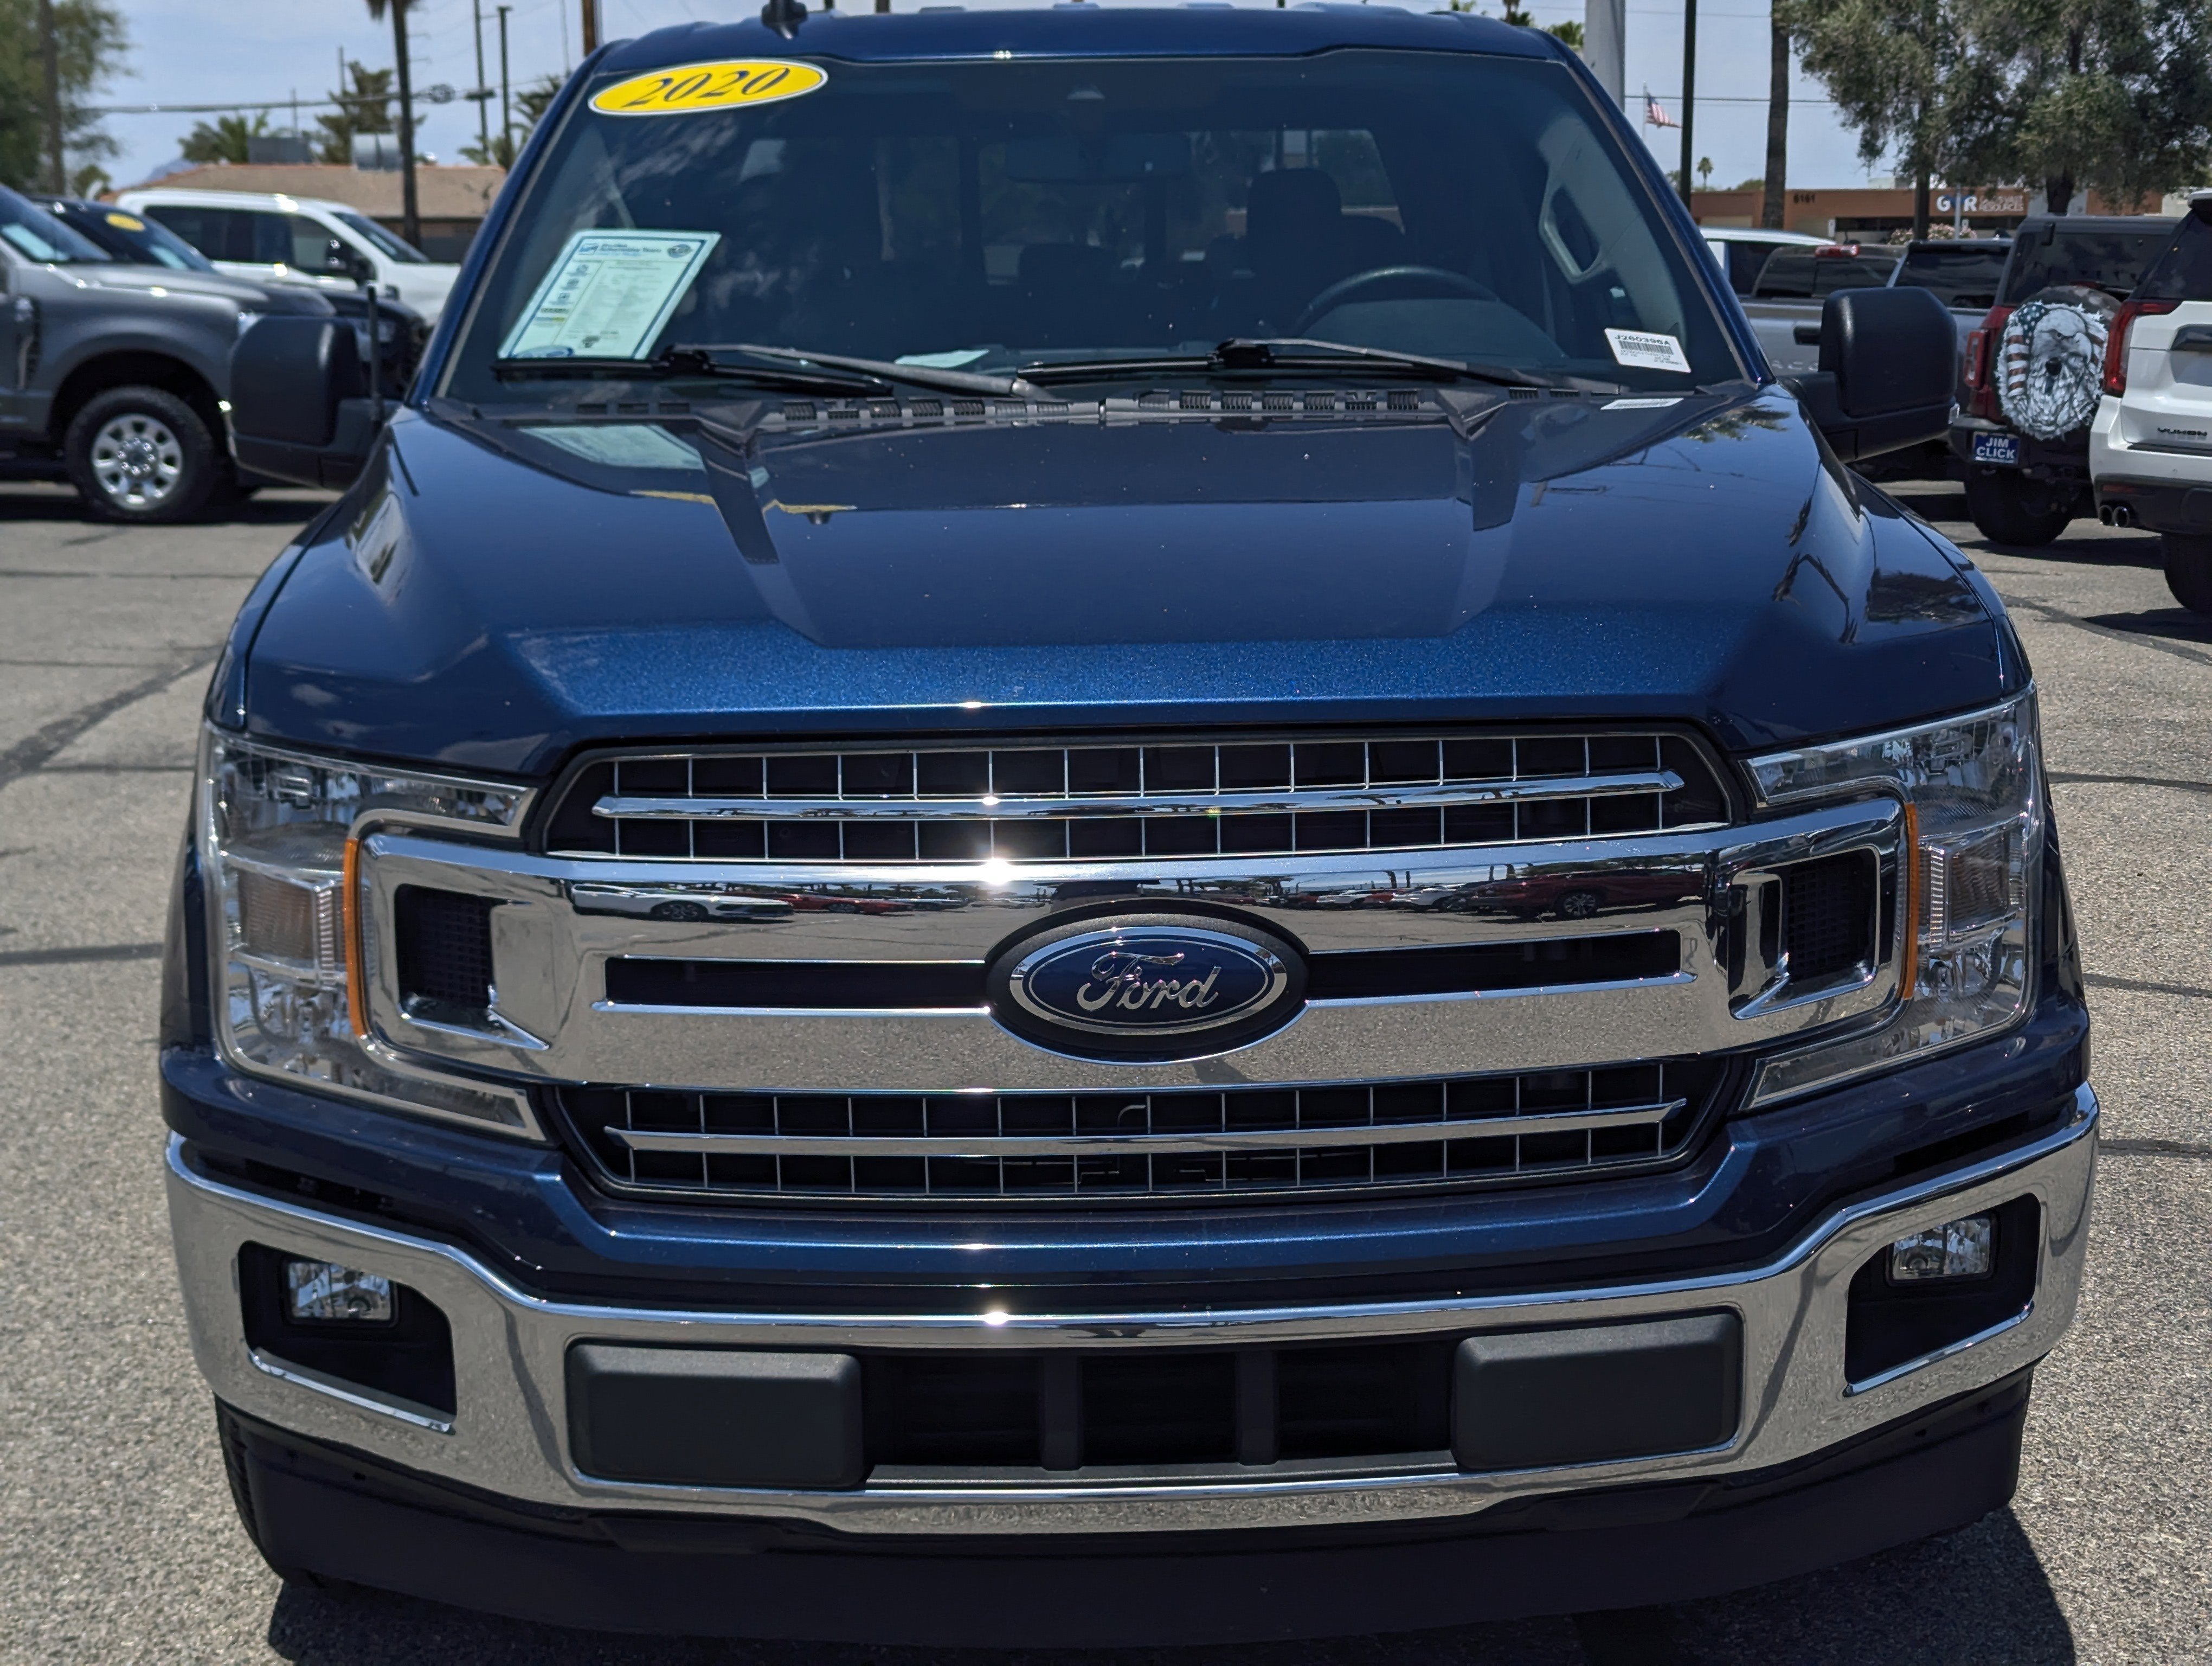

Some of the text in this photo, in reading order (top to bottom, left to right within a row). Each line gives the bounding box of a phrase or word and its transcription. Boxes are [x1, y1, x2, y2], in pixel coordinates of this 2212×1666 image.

[620, 67, 791, 108] 2020
[2157, 427, 2208, 436] YUKON
[1985, 437, 2009, 448] JIM
[1976, 446, 2015, 459] CLICK
[1076, 951, 1221, 1011] Ford
